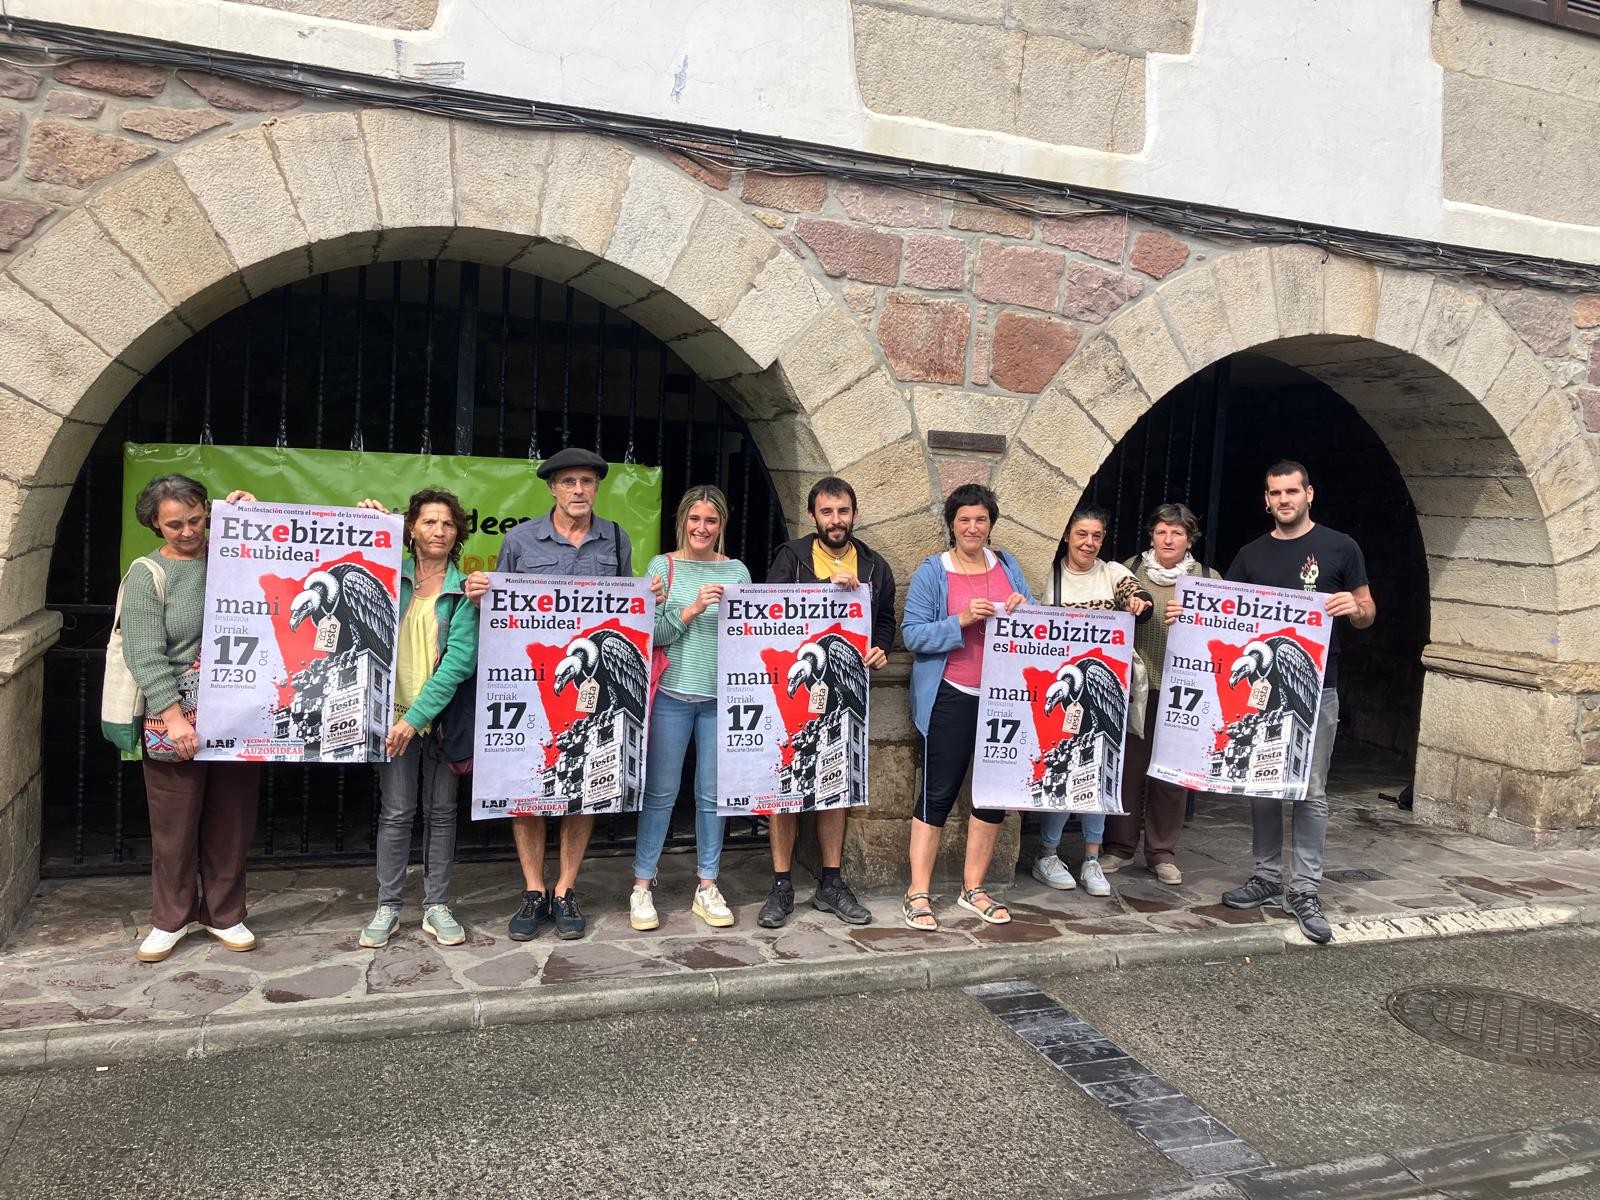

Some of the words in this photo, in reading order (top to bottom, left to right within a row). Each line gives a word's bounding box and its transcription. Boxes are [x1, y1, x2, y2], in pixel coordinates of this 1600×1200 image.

[238, 506, 282, 514] Manifestación
[221, 516, 392, 548] Etxebizitza
[220, 544, 320, 562] eskubidea!
[1195, 581, 1232, 590] Manifestación
[216, 596, 280, 616] mani
[490, 588, 646, 614] Etxebizitza
[727, 596, 864, 620] Etxebizitza
[1182, 589, 1322, 627] Etxebizitza
[214, 624, 248, 634] Urriak
[490, 614, 581, 630] eskubidea!
[727, 622, 809, 636] eskubidea!
[1178, 612, 1260, 633] eskubidea!
[324, 624, 338, 648] testa
[994, 617, 1125, 645] Etxebizitza
[214, 635, 259, 666] 17
[993, 640, 1070, 656] eskubidea!
[258, 650, 268, 666] Oct
[1172, 656, 1222, 674] mani
[211, 668, 256, 684] 17:30
[487, 663, 545, 682] mani
[726, 668, 779, 686] mani
[1170, 676, 1196, 687] Urriak
[486, 692, 518, 701] Urriak
[586, 686, 596, 709] testa
[726, 694, 755, 704] Urriak
[816, 688, 826, 710] testa
[988, 686, 1038, 702] mani
[1168, 686, 1204, 712] 17
[1256, 685, 1268, 706] testa
[329, 698, 360, 712] Testa
[1202, 701, 1210, 714] Oct
[486, 702, 527, 730] 17
[726, 704, 764, 731] 17
[987, 709, 1013, 718] Urriak
[1071, 709, 1082, 730] testa
[1165, 710, 1200, 726] 17:30
[329, 718, 358, 732] 500
[526, 714, 536, 729] Oct
[764, 716, 772, 730] Oct
[326, 728, 359, 738] viviendas
[986, 718, 1020, 744] 17
[1020, 732, 1028, 744] Oct
[206, 738, 236, 748] LAB
[484, 732, 526, 746] 17:30
[726, 733, 764, 746] 17:30
[242, 746, 304, 754] AUZOKIDEAK
[984, 746, 1018, 760] 17:30
[1256, 752, 1282, 761] Testa
[590, 754, 616, 769] Testa
[821, 751, 843, 766] Testa
[822, 770, 842, 784] 500
[1072, 774, 1095, 786] Testa
[1254, 768, 1278, 778] 500
[590, 774, 614, 788] 500
[482, 798, 508, 808] LAB
[726, 797, 750, 806] LAB
[756, 800, 804, 810] AUZOKIDEAK
[1073, 792, 1094, 804] 500
[514, 803, 568, 812] AUZOKIDEAK
